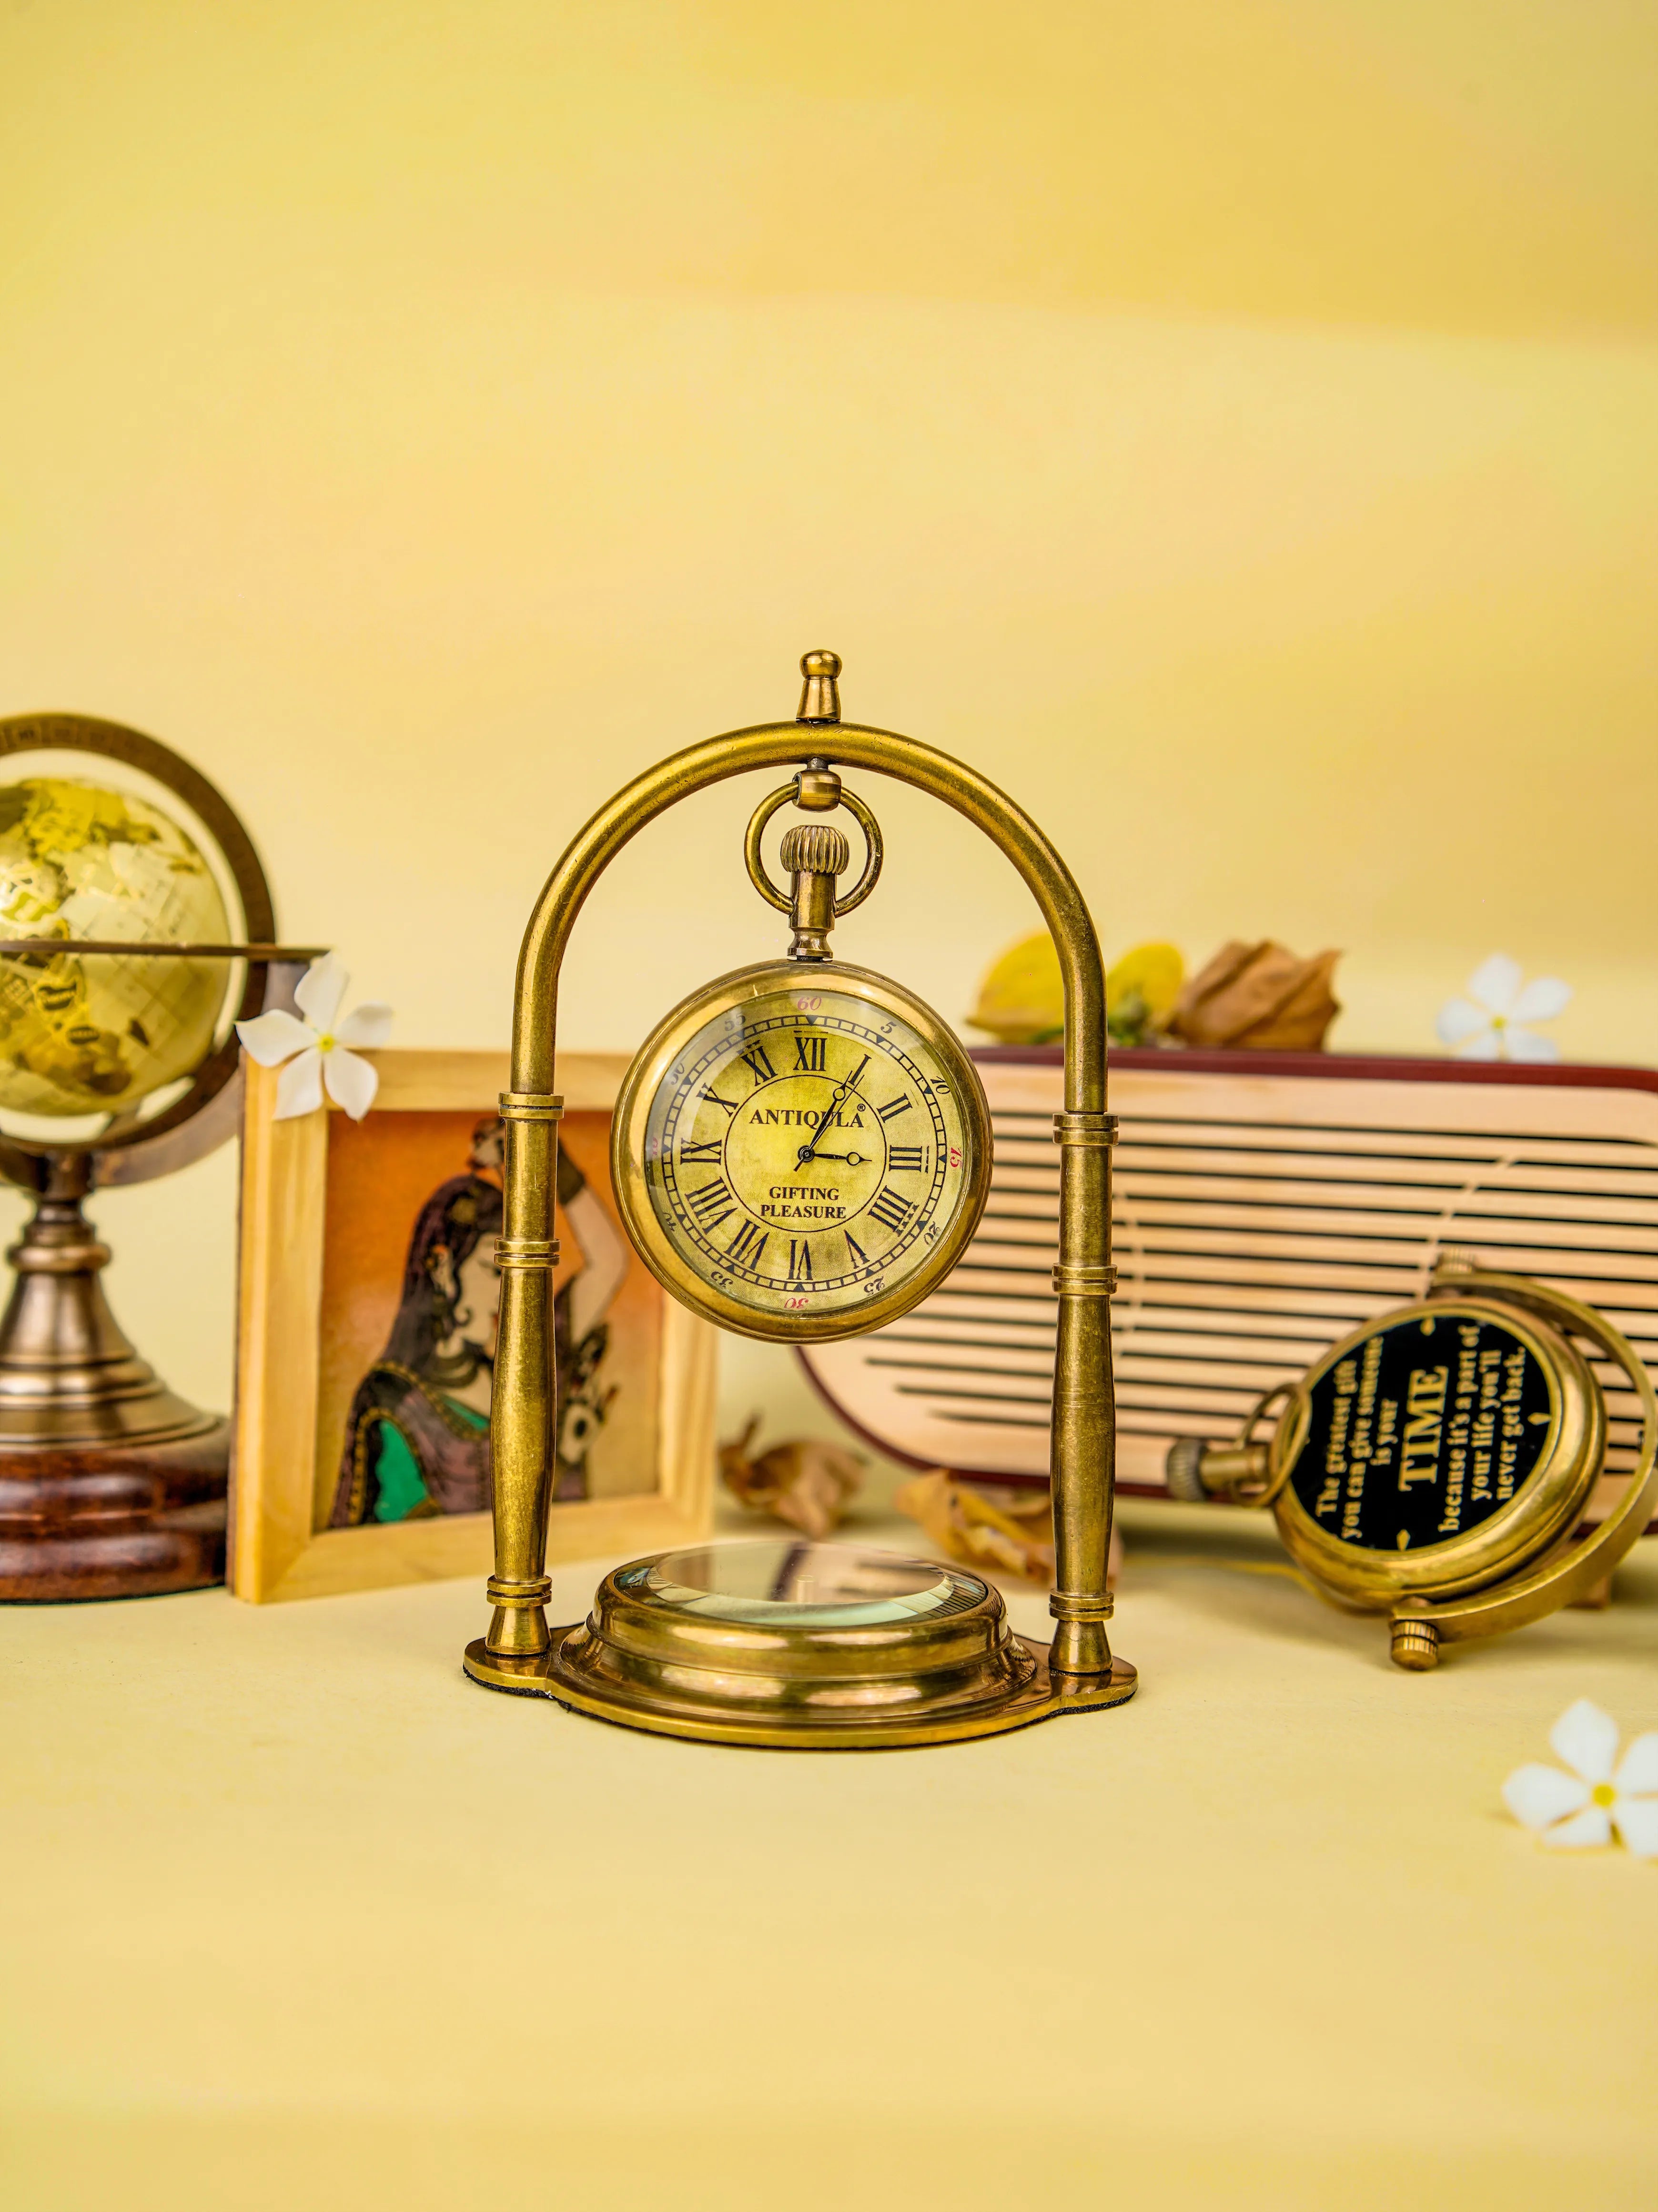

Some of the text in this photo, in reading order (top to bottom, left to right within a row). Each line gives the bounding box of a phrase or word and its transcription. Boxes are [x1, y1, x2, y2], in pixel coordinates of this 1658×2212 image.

[798, 996, 822, 1010] 60
[724, 1014, 746, 1031] 55
[880, 1021, 897, 1033] 5
[739, 1043, 778, 1086] XI
[793, 1037, 828, 1071] XII
[696, 1082, 739, 1118] X
[930, 1076, 951, 1094] 10
[876, 1092, 913, 1123] II
[680, 1138, 722, 1165] IX
[888, 1144, 924, 1172] III
[950, 1147, 962, 1168] 15
[685, 1176, 738, 1234] VIII
[760, 1204, 846, 1219] PLEASURE
[769, 1186, 839, 1201] GIFTING
[868, 1185, 918, 1235] IIII
[724, 1219, 770, 1271] VII
[843, 1229, 870, 1269] V
[923, 1221, 940, 1246] 20
[787, 1240, 814, 1280] VI
[784, 1297, 809, 1309] 30
[1315, 1360, 1358, 1517] The greatest gift
[1341, 1335, 1384, 1539] you can give someone
[1369, 1398, 1398, 1466] is your
[1399, 1366, 1449, 1491] TIME
[1437, 1324, 1480, 1532] because it's a part of
[1471, 1349, 1502, 1501] your life you'll
[1496, 1346, 1526, 1500] never get back.
